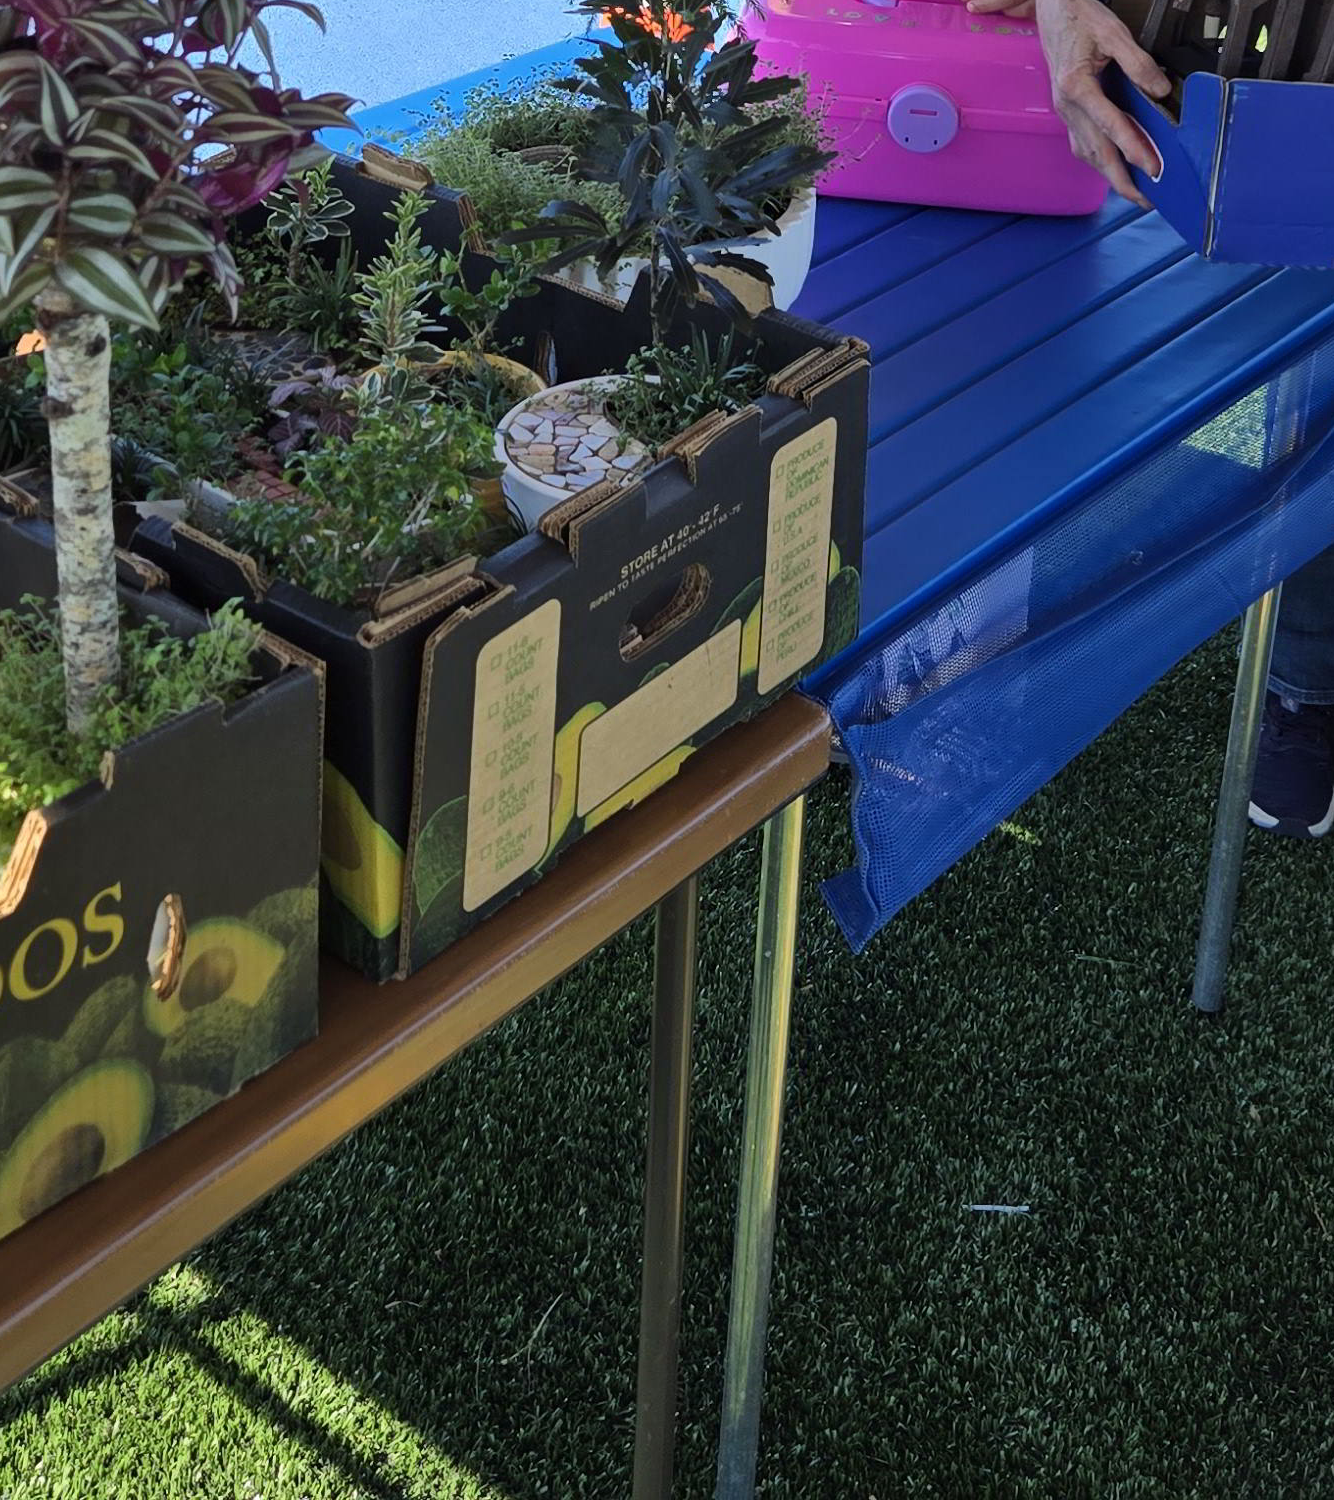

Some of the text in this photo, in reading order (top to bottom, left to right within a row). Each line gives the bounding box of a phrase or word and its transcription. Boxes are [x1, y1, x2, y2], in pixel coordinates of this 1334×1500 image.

[787, 439, 825, 467] PRODUCE
[784, 494, 821, 524] PRODUCE
[620, 545, 658, 579] STORE
[660, 534, 675, 551] AT
[782, 532, 818, 563] PRODUCE
[589, 586, 616, 611] RIPEN
[618, 579, 629, 592] TO
[631, 563, 655, 582] TASTE
[707, 521, 717, 533] AT
[779, 573, 816, 604] PRODUCE
[506, 638, 543, 670] COUNT
[505, 655, 534, 685] BAGS
[503, 685, 540, 718] COUNT
[503, 703, 532, 732] BAGS
[501, 732, 538, 765] COUNT
